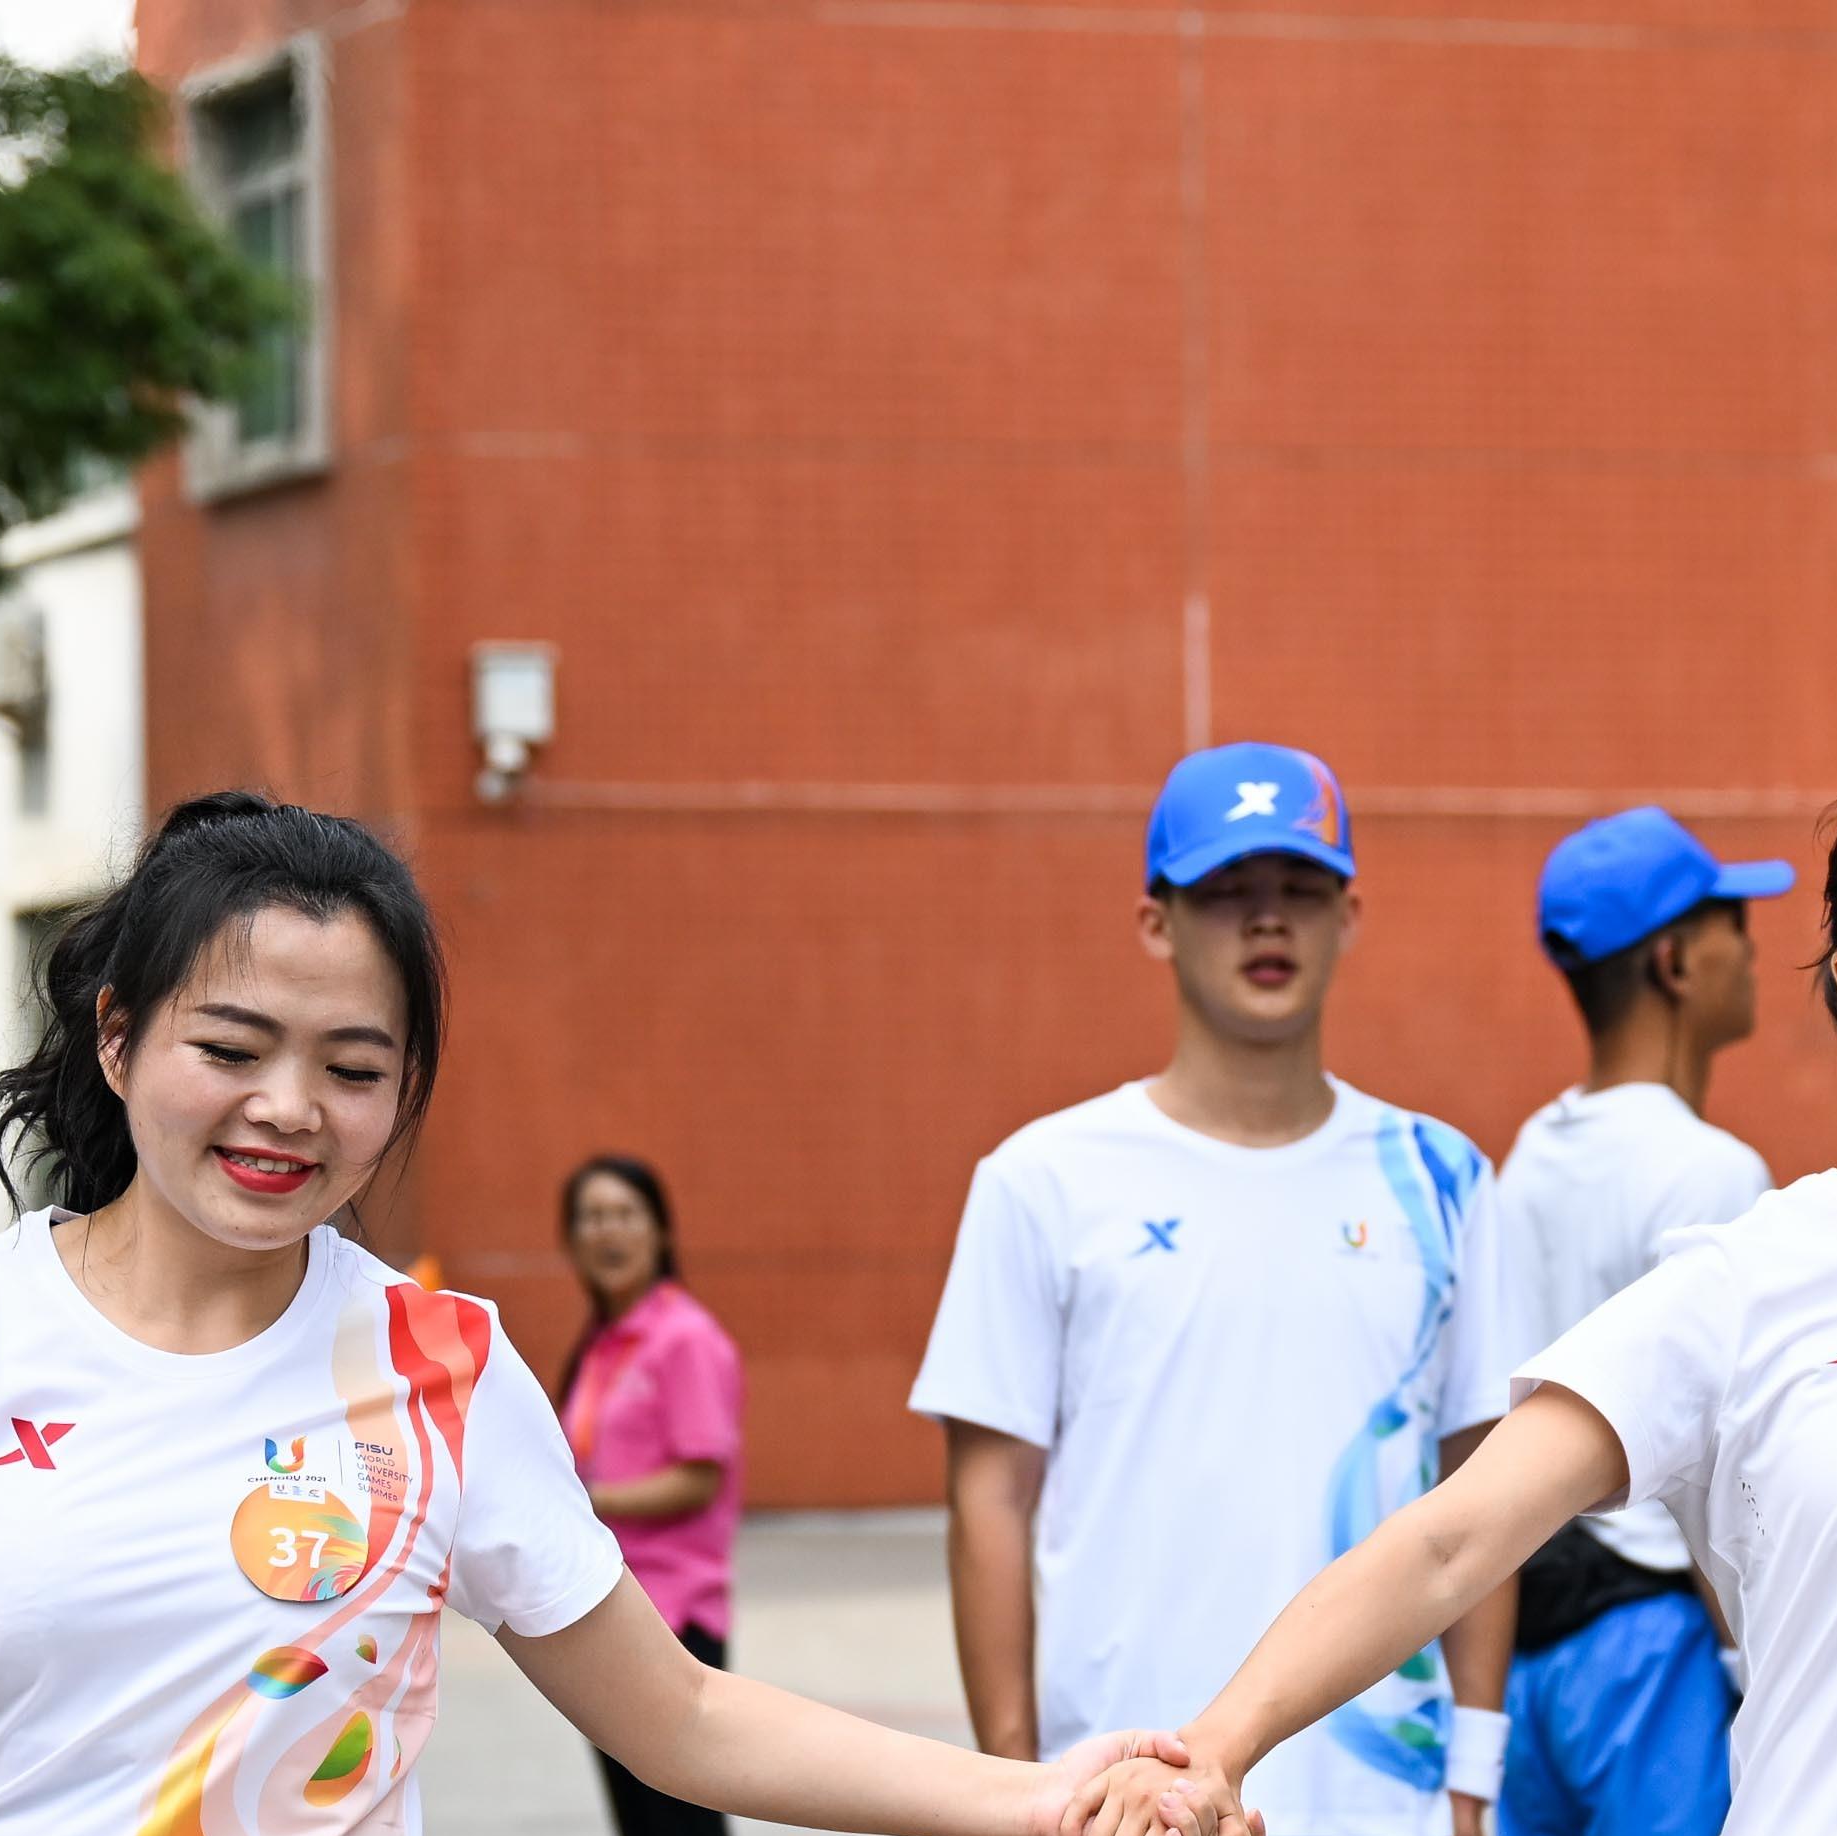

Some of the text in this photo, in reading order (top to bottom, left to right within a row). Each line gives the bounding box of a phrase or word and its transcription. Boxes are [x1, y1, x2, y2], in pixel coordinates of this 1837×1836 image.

[354, 1442, 393, 1456] FISU
[356, 1453, 395, 1467] WORLD
[357, 1462, 414, 1484] UNIVERSITY
[357, 1473, 392, 1490] GAMES
[357, 1482, 398, 1503] SUMMER
[268, 1527, 329, 1569] 37
